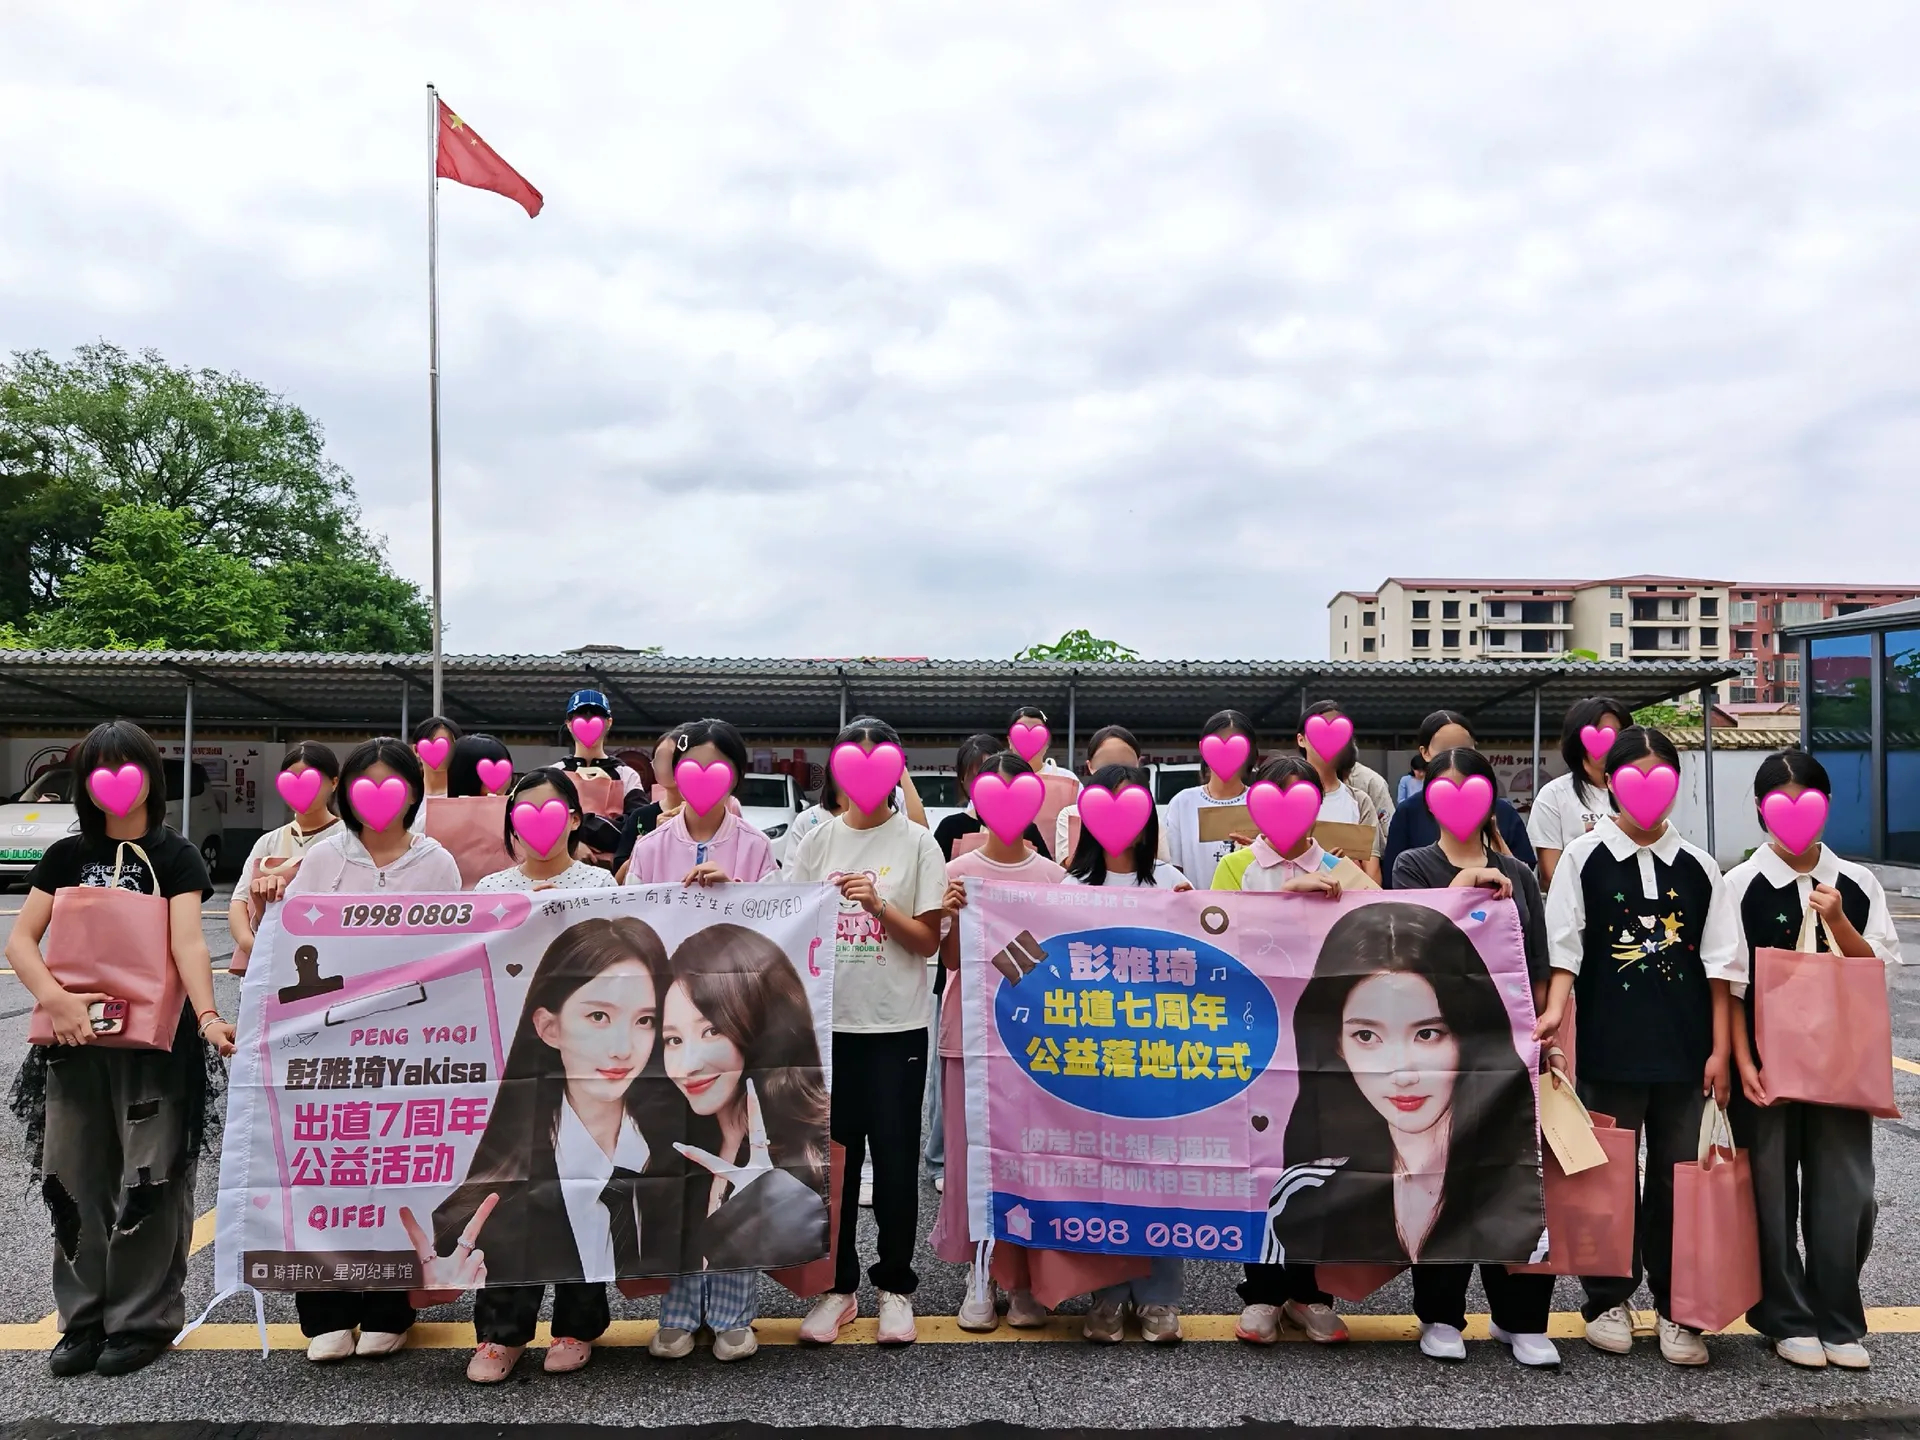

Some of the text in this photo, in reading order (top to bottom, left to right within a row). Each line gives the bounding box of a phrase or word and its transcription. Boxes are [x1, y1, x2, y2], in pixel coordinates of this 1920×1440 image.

[1581, 813, 1604, 822] SEV
[340, 902, 473, 928] 1998 0803
[1068, 942, 1198, 987] 彭雅琦
[1044, 989, 1228, 1032] 出道七周年
[349, 1024, 477, 1046] PENG YAQI
[285, 1056, 487, 1091] 彭雅琦Yakisa
[1025, 1037, 1252, 1081] 公益落地仪式
[293, 1097, 489, 1141] 出道7周年
[1020, 1127, 1231, 1164] 彼岸总比想象遥远
[290, 1142, 455, 1187] 公益活动
[308, 1204, 385, 1231] QIFEI
[1049, 1218, 1243, 1251] 1998 0803
[274, 1262, 413, 1280] 琦菲RY_星河纪事馆
